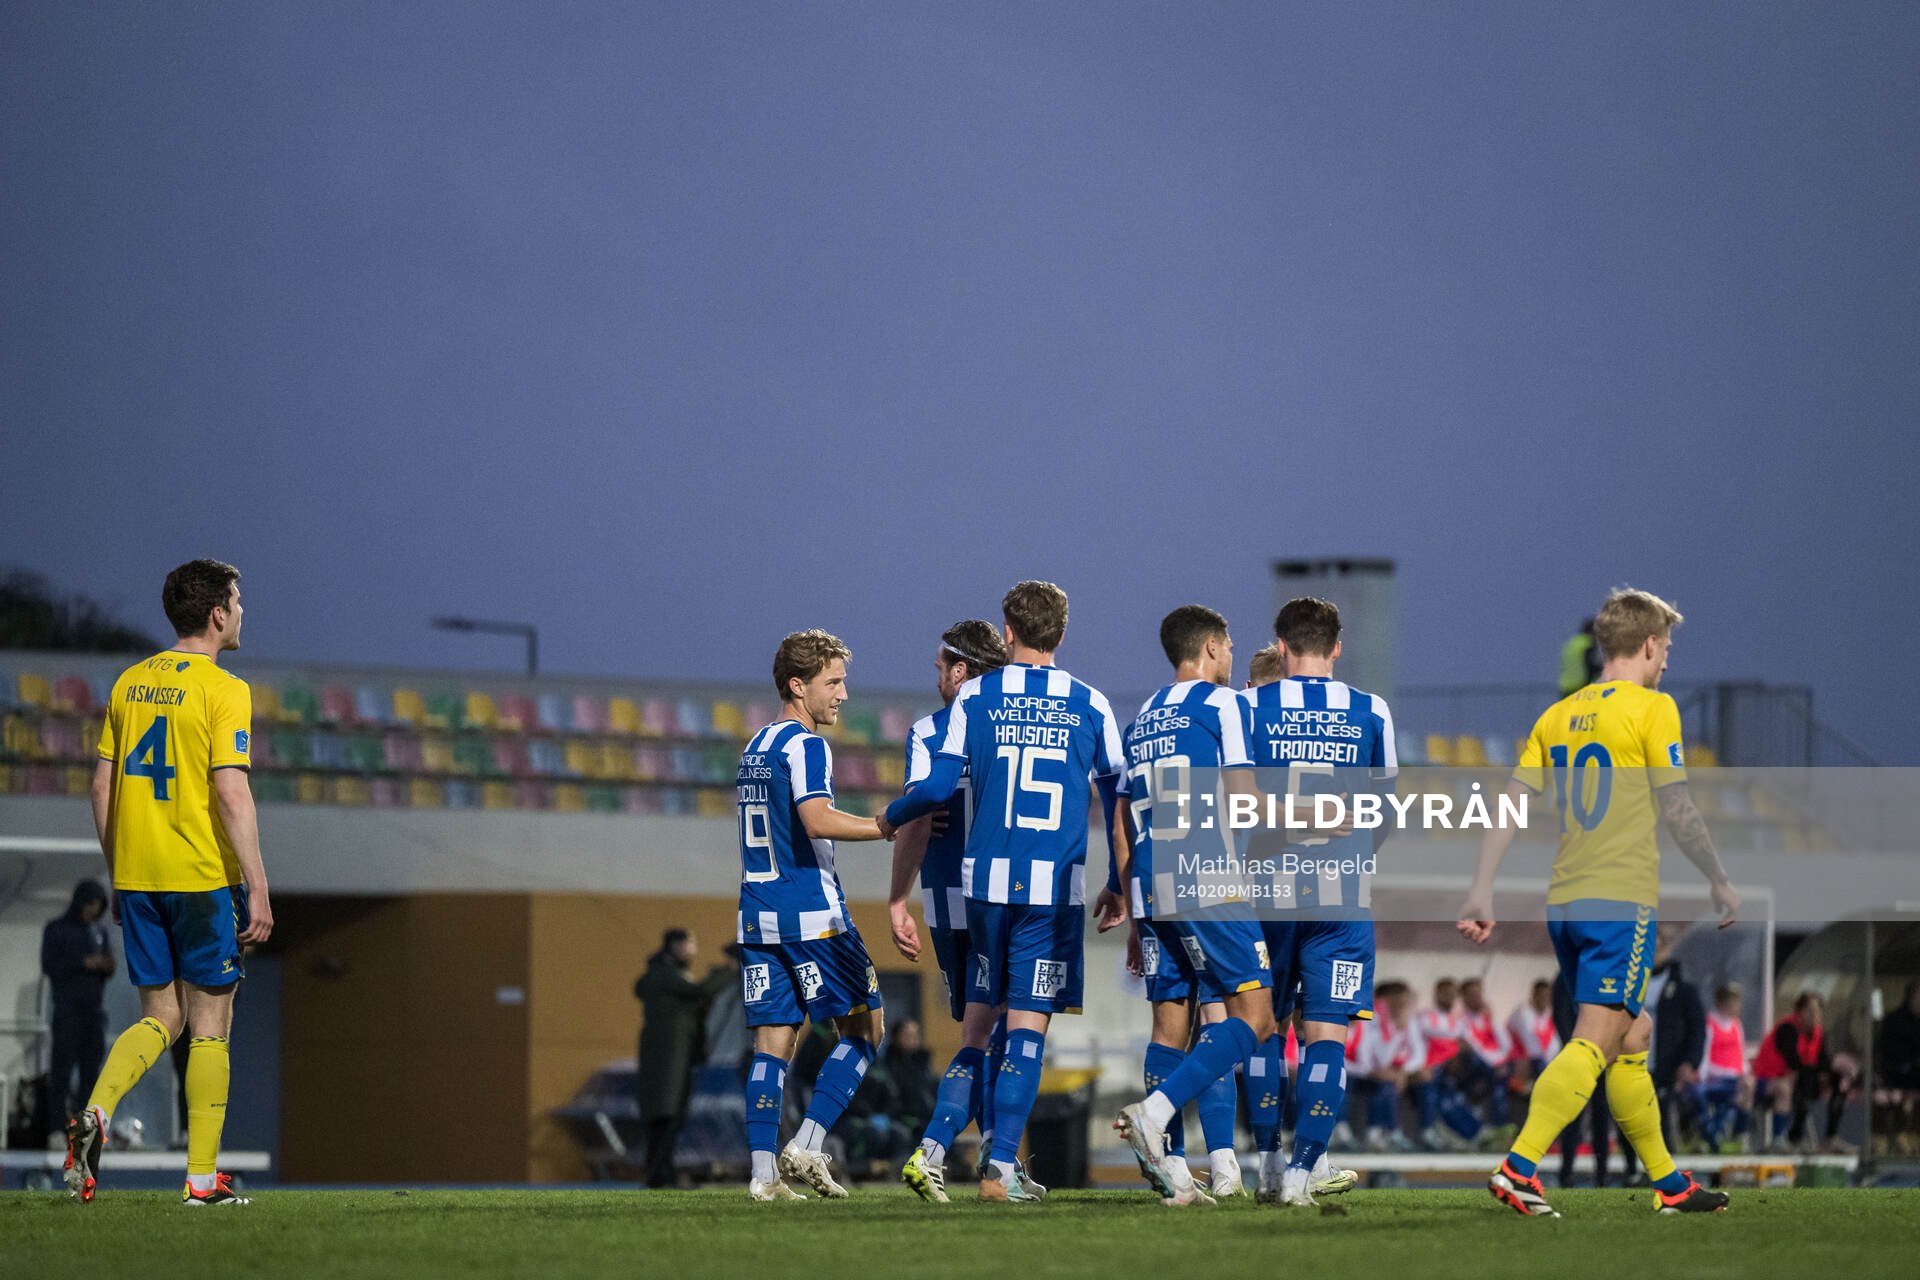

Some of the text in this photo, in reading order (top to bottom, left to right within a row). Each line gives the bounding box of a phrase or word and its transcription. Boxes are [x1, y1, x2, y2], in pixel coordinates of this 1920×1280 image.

[126, 685, 187, 706] RASMUSSEN
[1003, 697, 1067, 711] NORDIC
[988, 709, 1081, 727] WELLNESS
[1136, 705, 1179, 726] NORDIC
[1282, 710, 1347, 724] NORDIC
[995, 725, 1070, 748] HAUSNER
[1266, 723, 1362, 739] WELLNESS
[125, 716, 175, 801] 4
[1269, 740, 1358, 764] TRONDSEN
[738, 767, 772, 779] ELLNESS
[997, 745, 1067, 832] 15
[1549, 742, 1613, 833] 10
[1127, 754, 1191, 846] 29
[1038, 963, 1062, 975] EFF
[1336, 963, 1358, 976] EFF
[800, 974, 818, 988] KT
[1038, 973, 1064, 985] EKT
[1336, 974, 1359, 987] EKT
[1035, 983, 1051, 994] IV
[1335, 985, 1348, 996] IV
